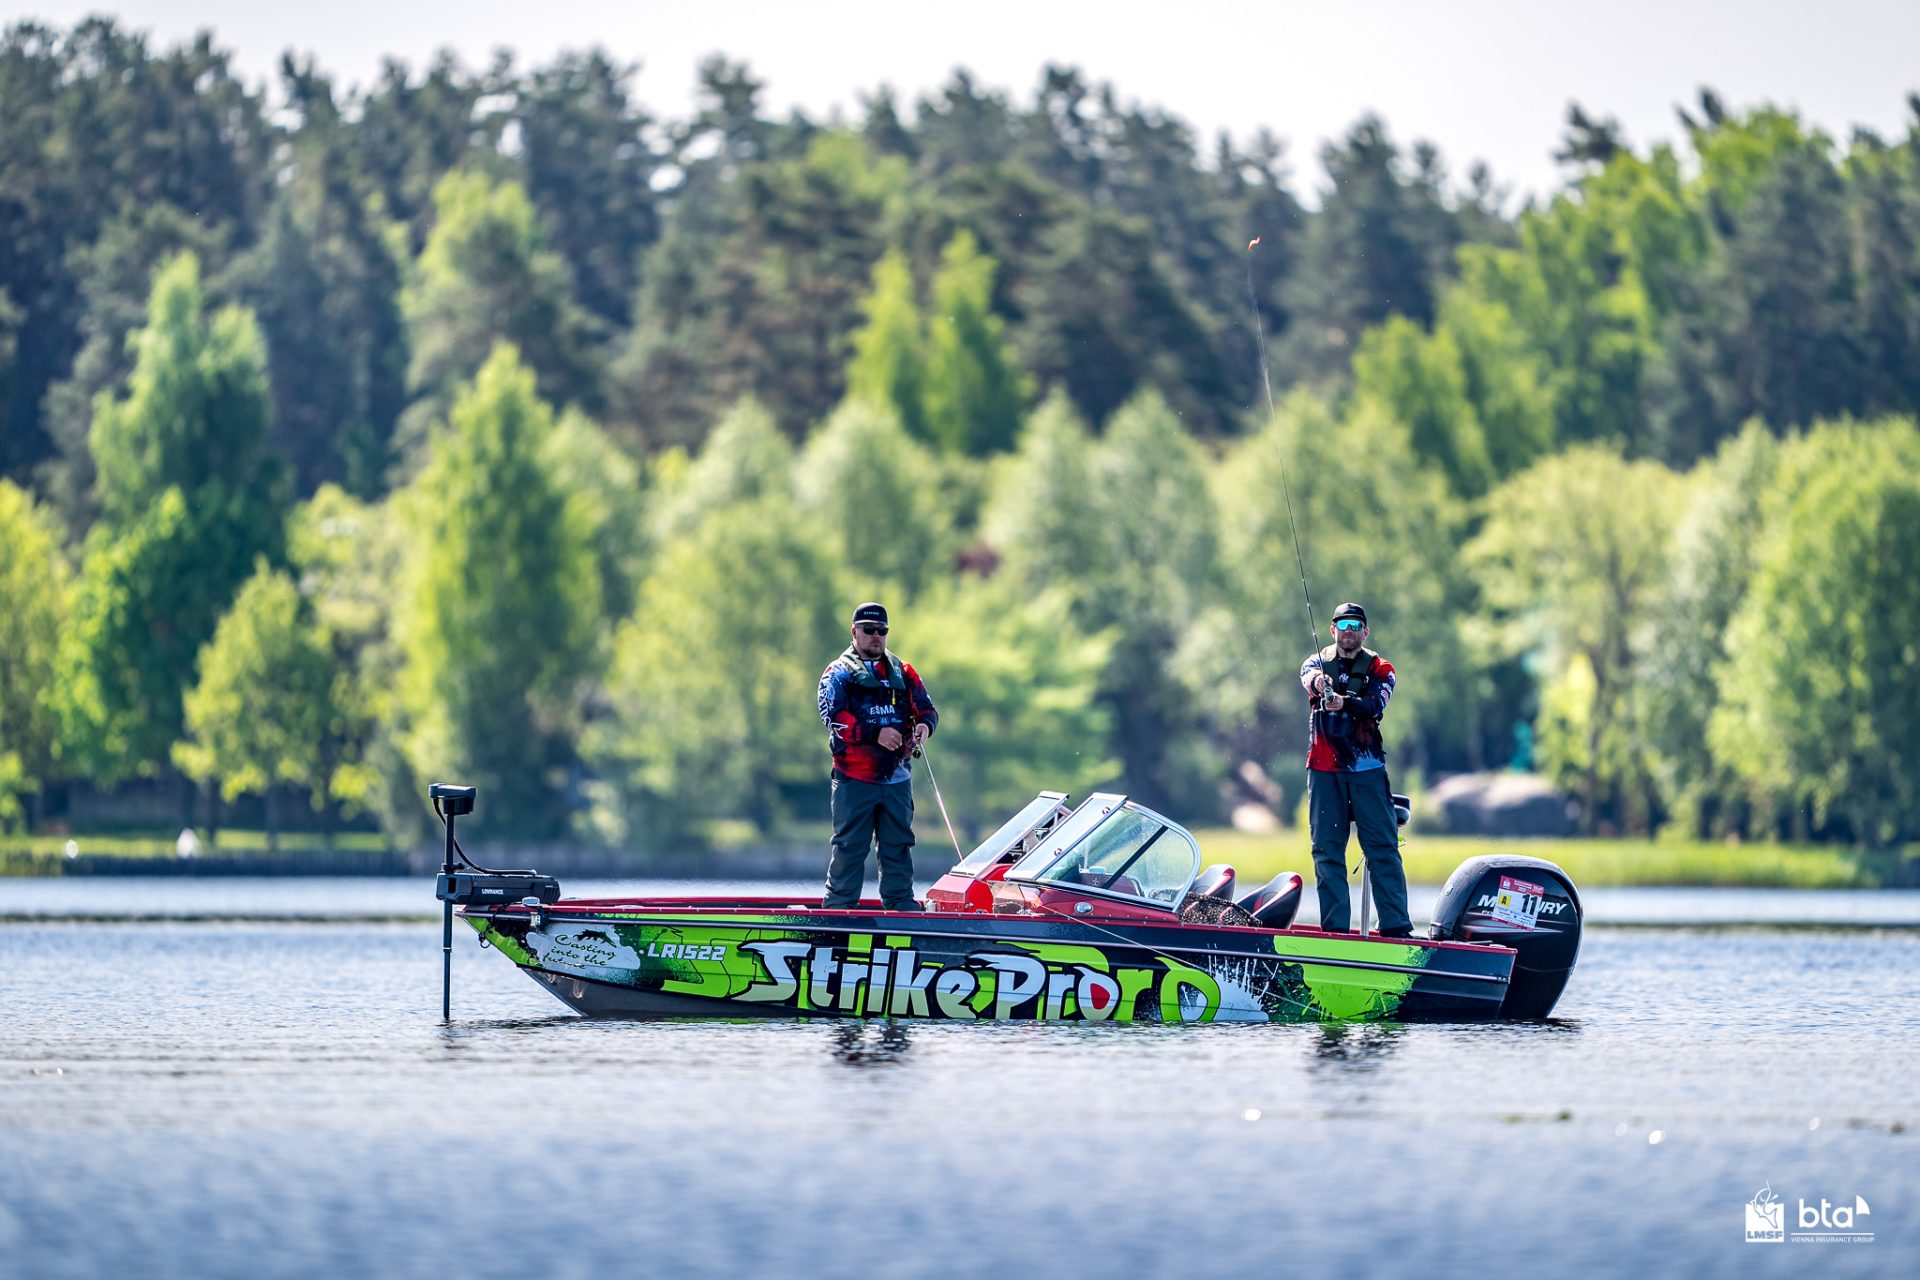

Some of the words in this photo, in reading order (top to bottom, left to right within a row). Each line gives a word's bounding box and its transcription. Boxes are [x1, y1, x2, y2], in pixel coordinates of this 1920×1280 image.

[870, 705, 896, 716] ESMA
[1477, 894, 1568, 915] MURY
[1502, 895, 1507, 904] A
[1521, 893, 1538, 916] 11
[551, 946, 580, 959] into
[584, 955, 607, 966] the
[554, 934, 617, 960] Casting
[647, 942, 727, 961] LR1522
[542, 952, 587, 970] future
